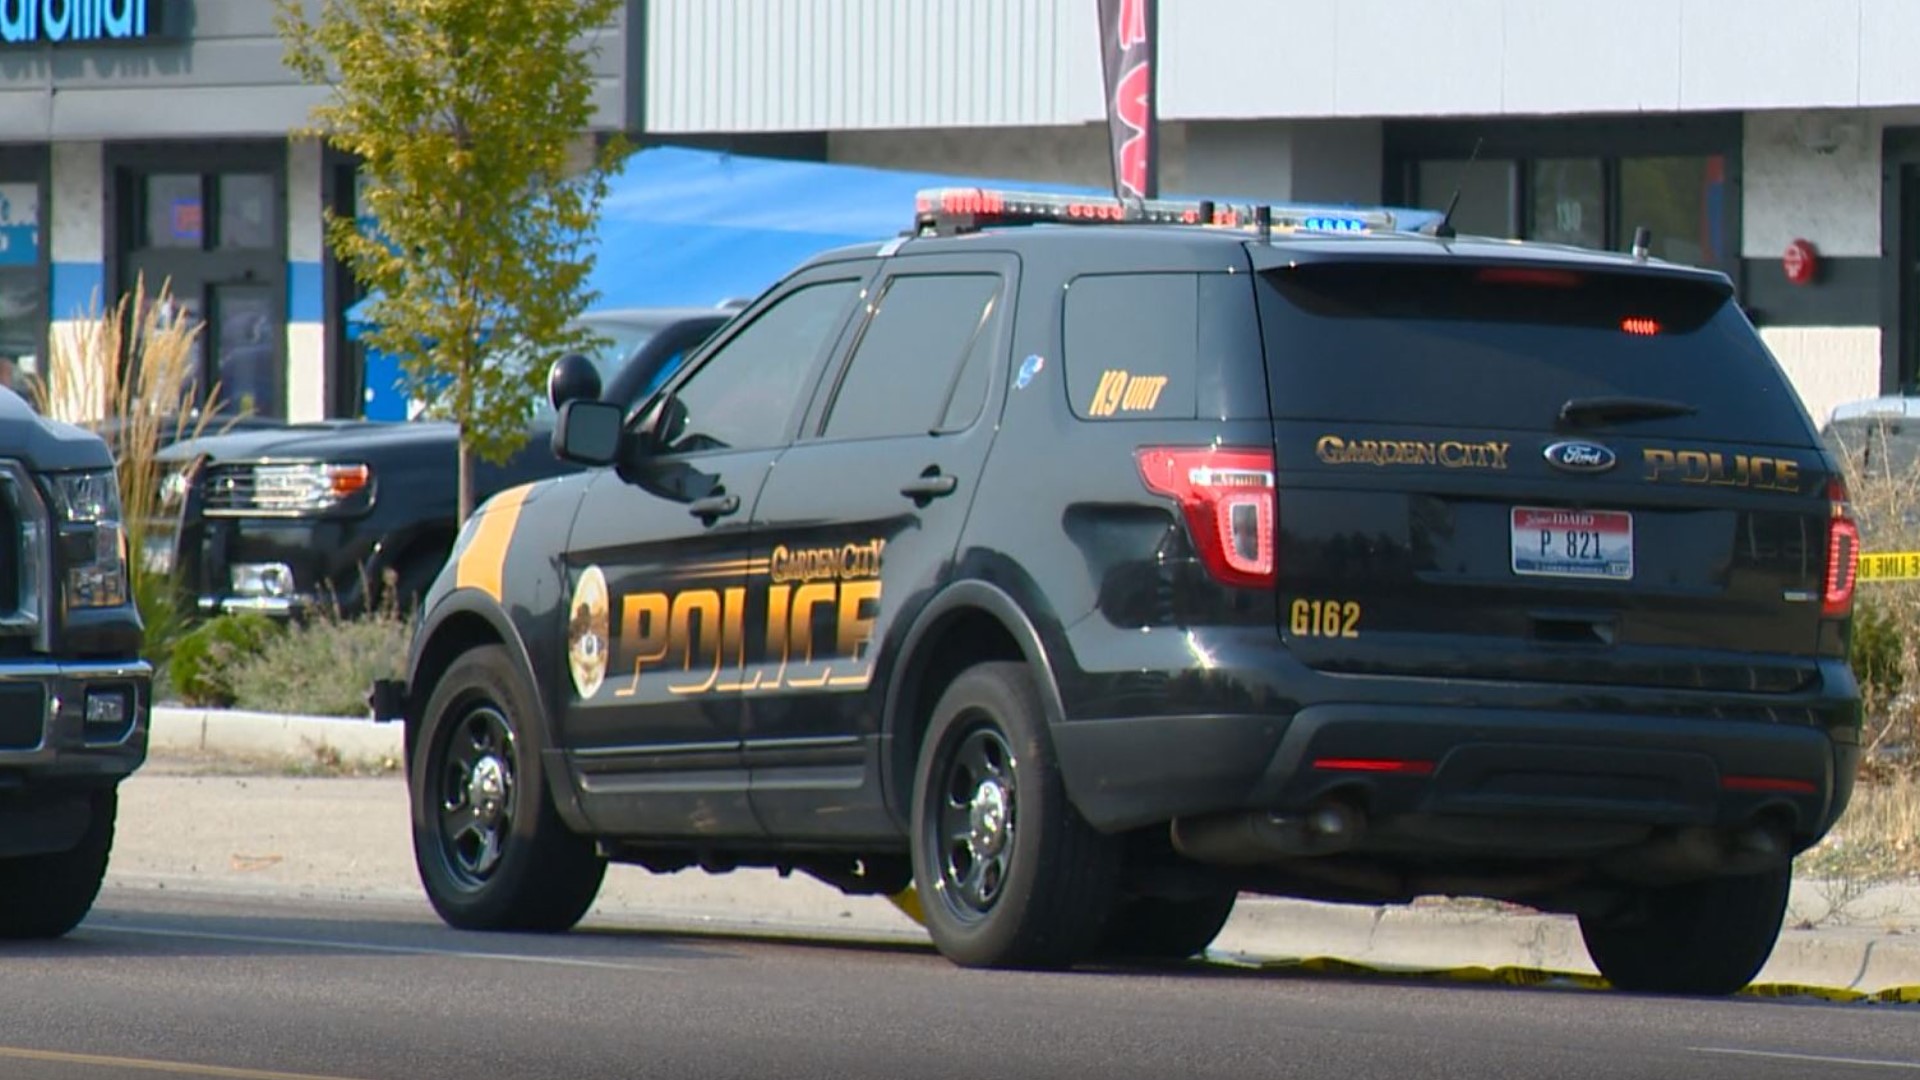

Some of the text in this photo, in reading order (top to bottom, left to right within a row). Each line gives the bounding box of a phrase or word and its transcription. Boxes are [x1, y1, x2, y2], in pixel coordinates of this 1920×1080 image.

[1089, 370, 1168, 416] K9 UNIT
[1316, 435, 1511, 469] GARDEN CITY
[1562, 444, 1602, 465] Ford
[1642, 448, 1799, 493] POLICE
[1553, 512, 1595, 526] IDAHO
[771, 538, 886, 583] GARDEN CITY
[1541, 529, 1603, 560] P 821
[615, 579, 882, 696] POLICE
[1291, 599, 1361, 638] G162
